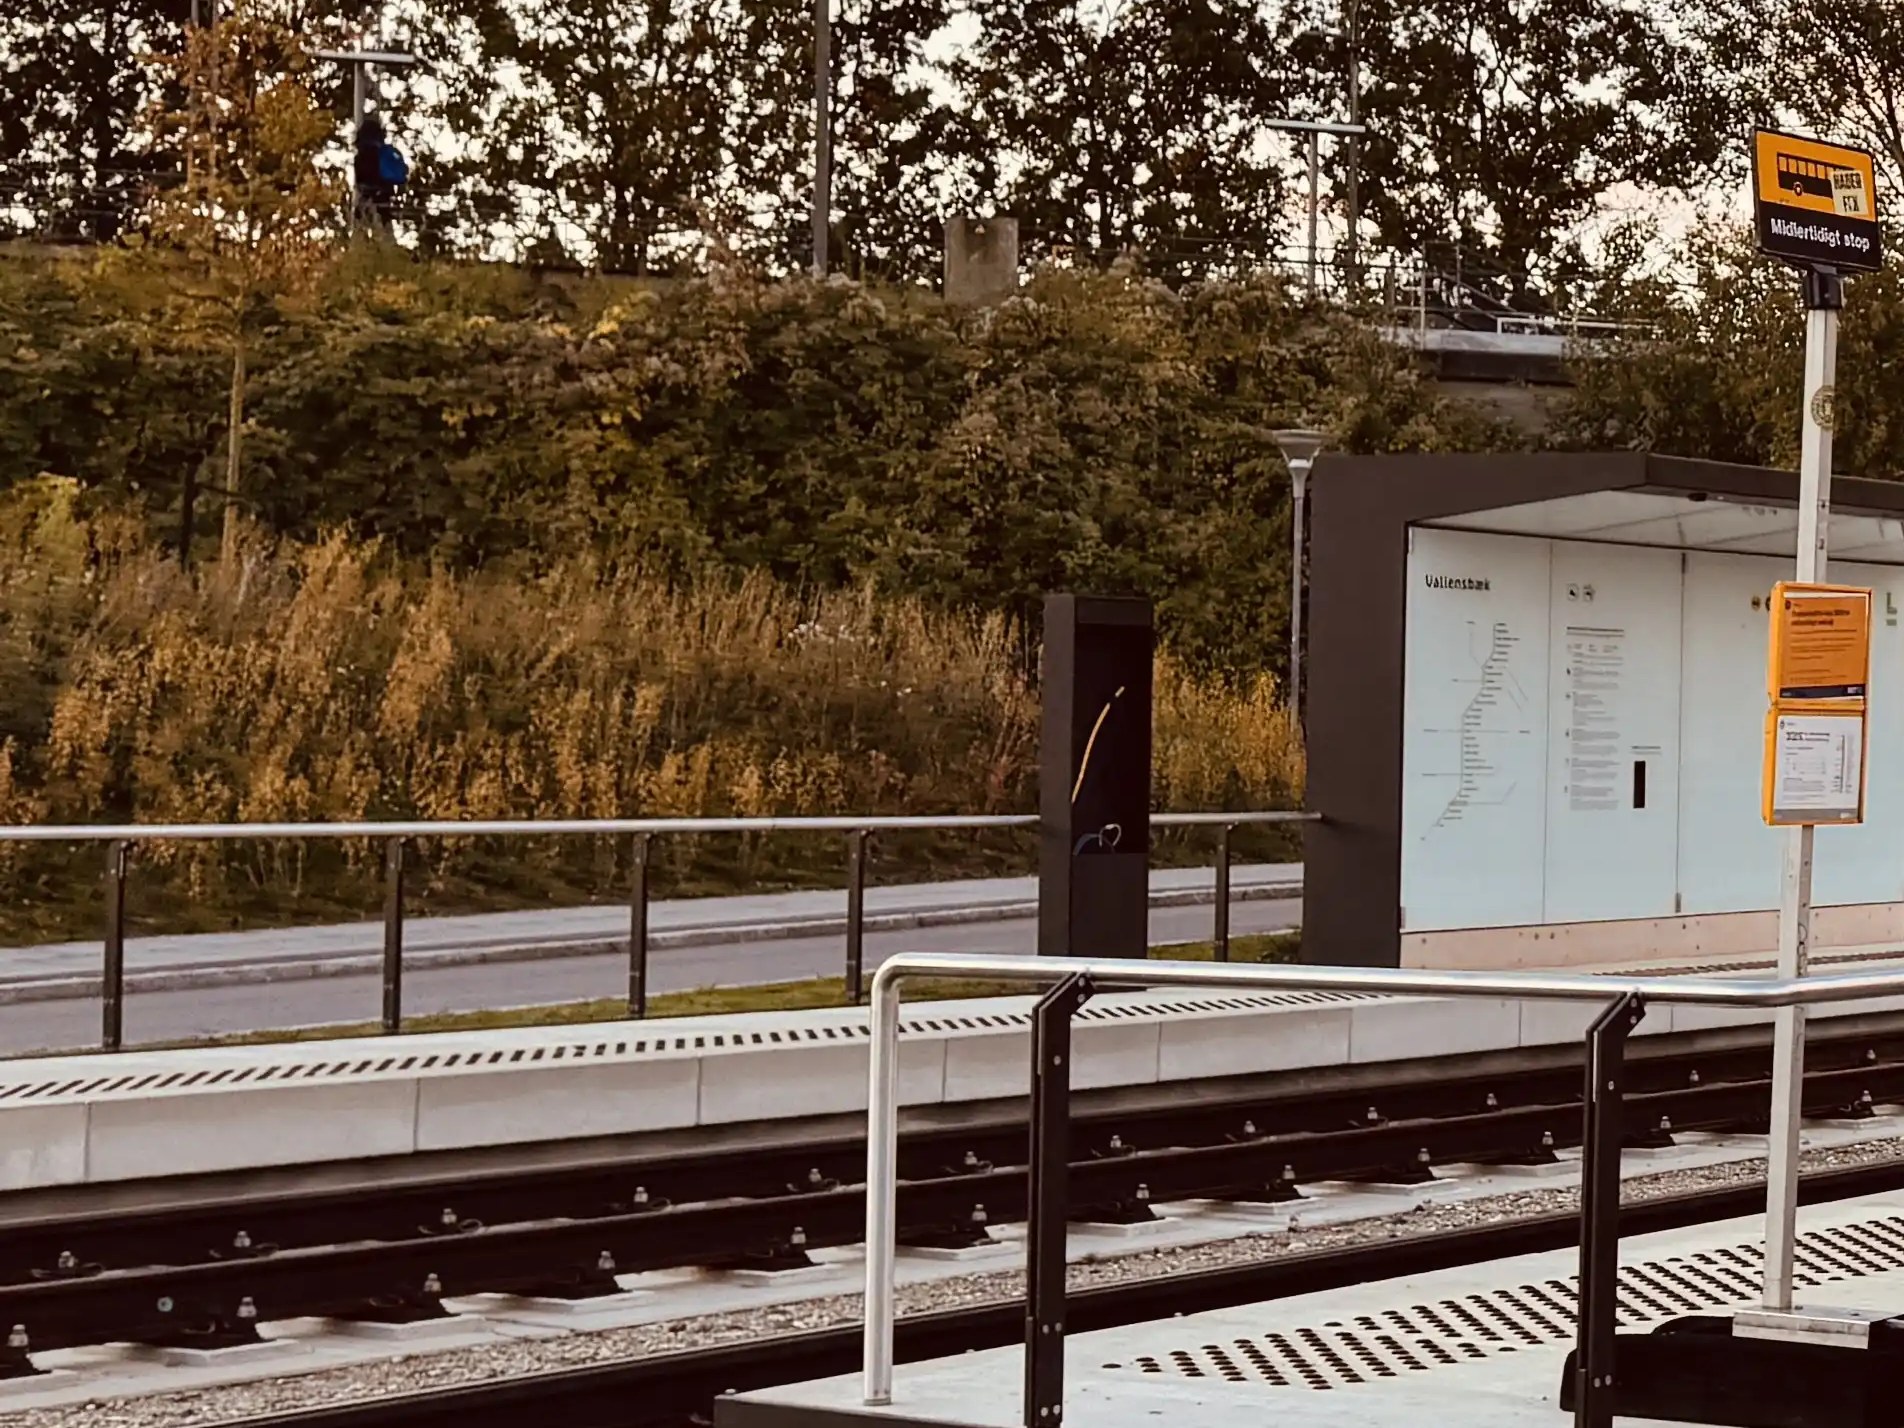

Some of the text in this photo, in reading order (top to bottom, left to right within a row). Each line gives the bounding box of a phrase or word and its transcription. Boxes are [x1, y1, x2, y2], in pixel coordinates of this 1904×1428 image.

[1770, 217, 1870, 253] Midlertidigt stop
[1425, 573, 1491, 591] Vallensbæk
